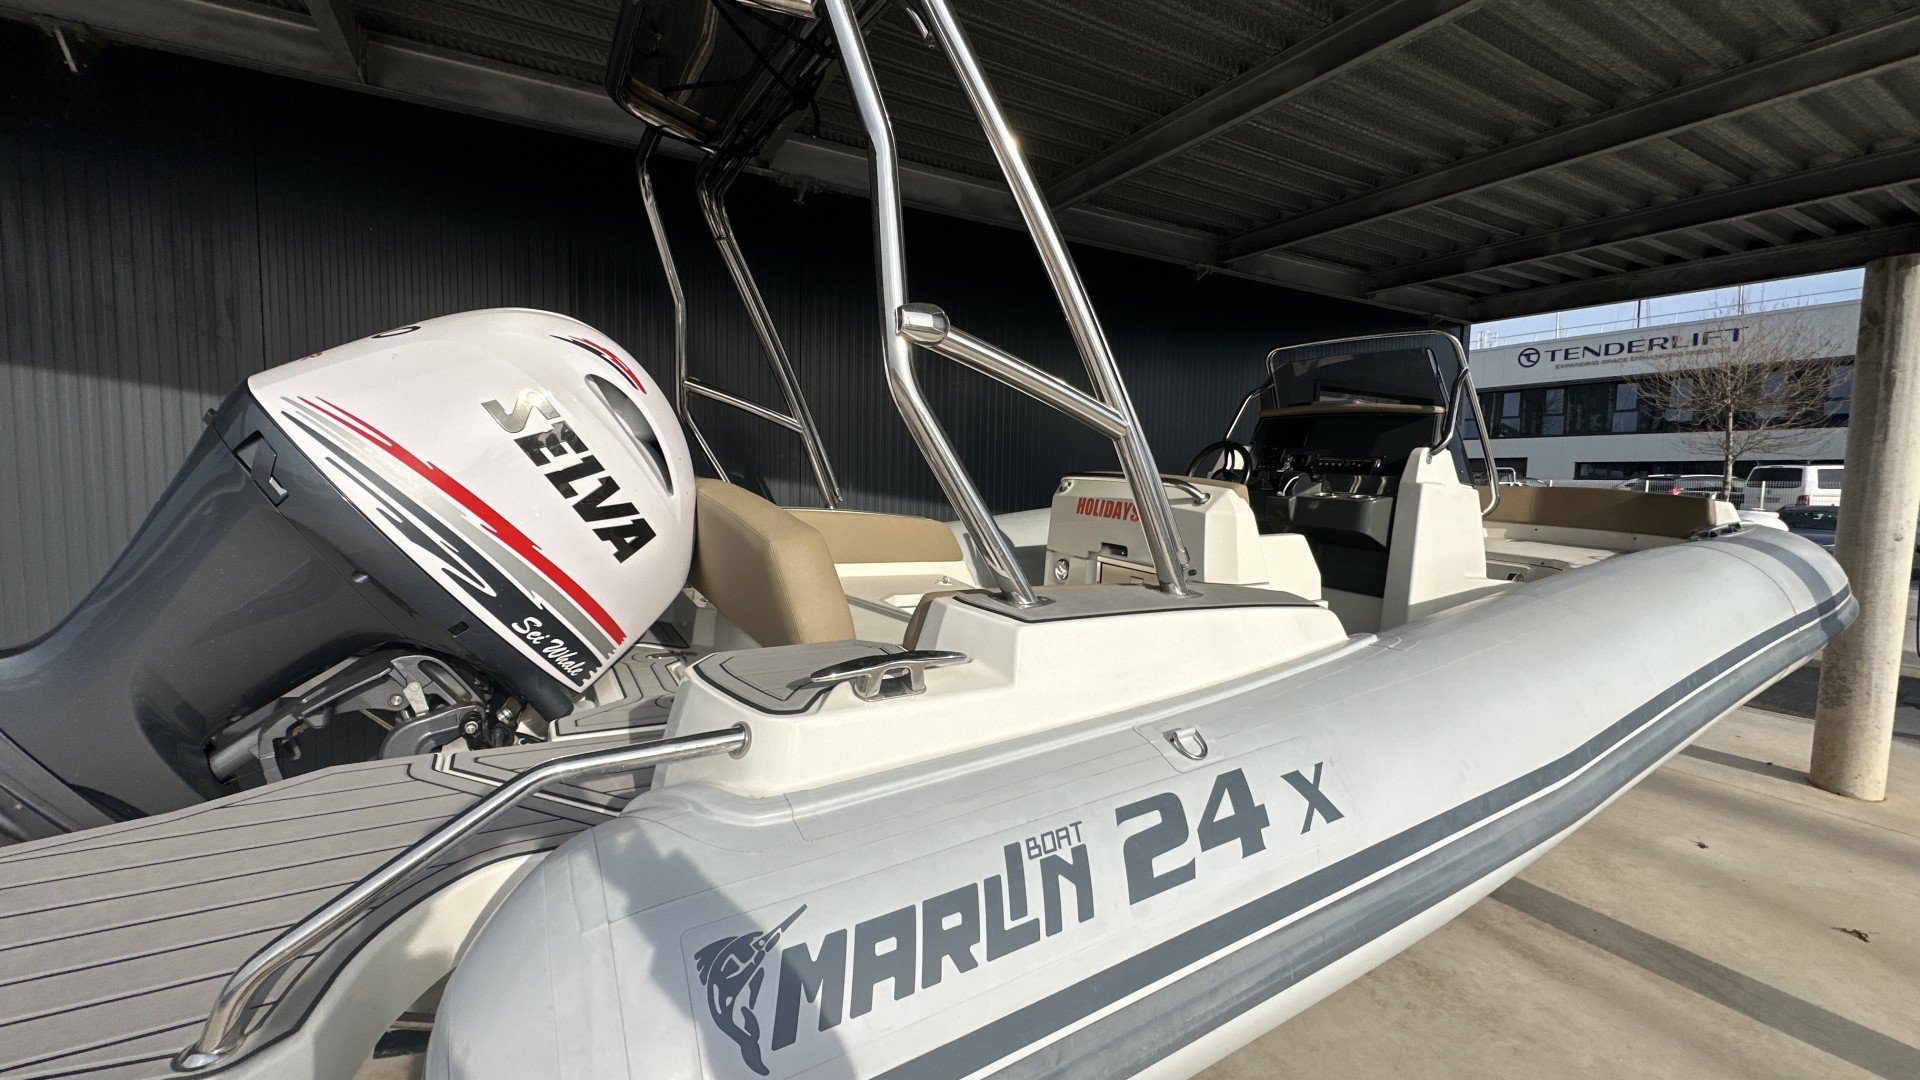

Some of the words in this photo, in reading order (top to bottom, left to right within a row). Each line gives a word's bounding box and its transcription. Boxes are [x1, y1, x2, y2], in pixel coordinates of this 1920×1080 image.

[1544, 326, 1749, 362] TENDERLIFT
[1555, 360, 1600, 370] EXPANDING
[1601, 356, 1629, 365] SPACE
[481, 387, 657, 564] SELVA
[511, 616, 551, 645] Sei
[542, 638, 587, 677] Whale
[1025, 820, 1083, 860] BOAT
[771, 840, 1095, 1051] MARLIN
[1114, 767, 1270, 906] 24
